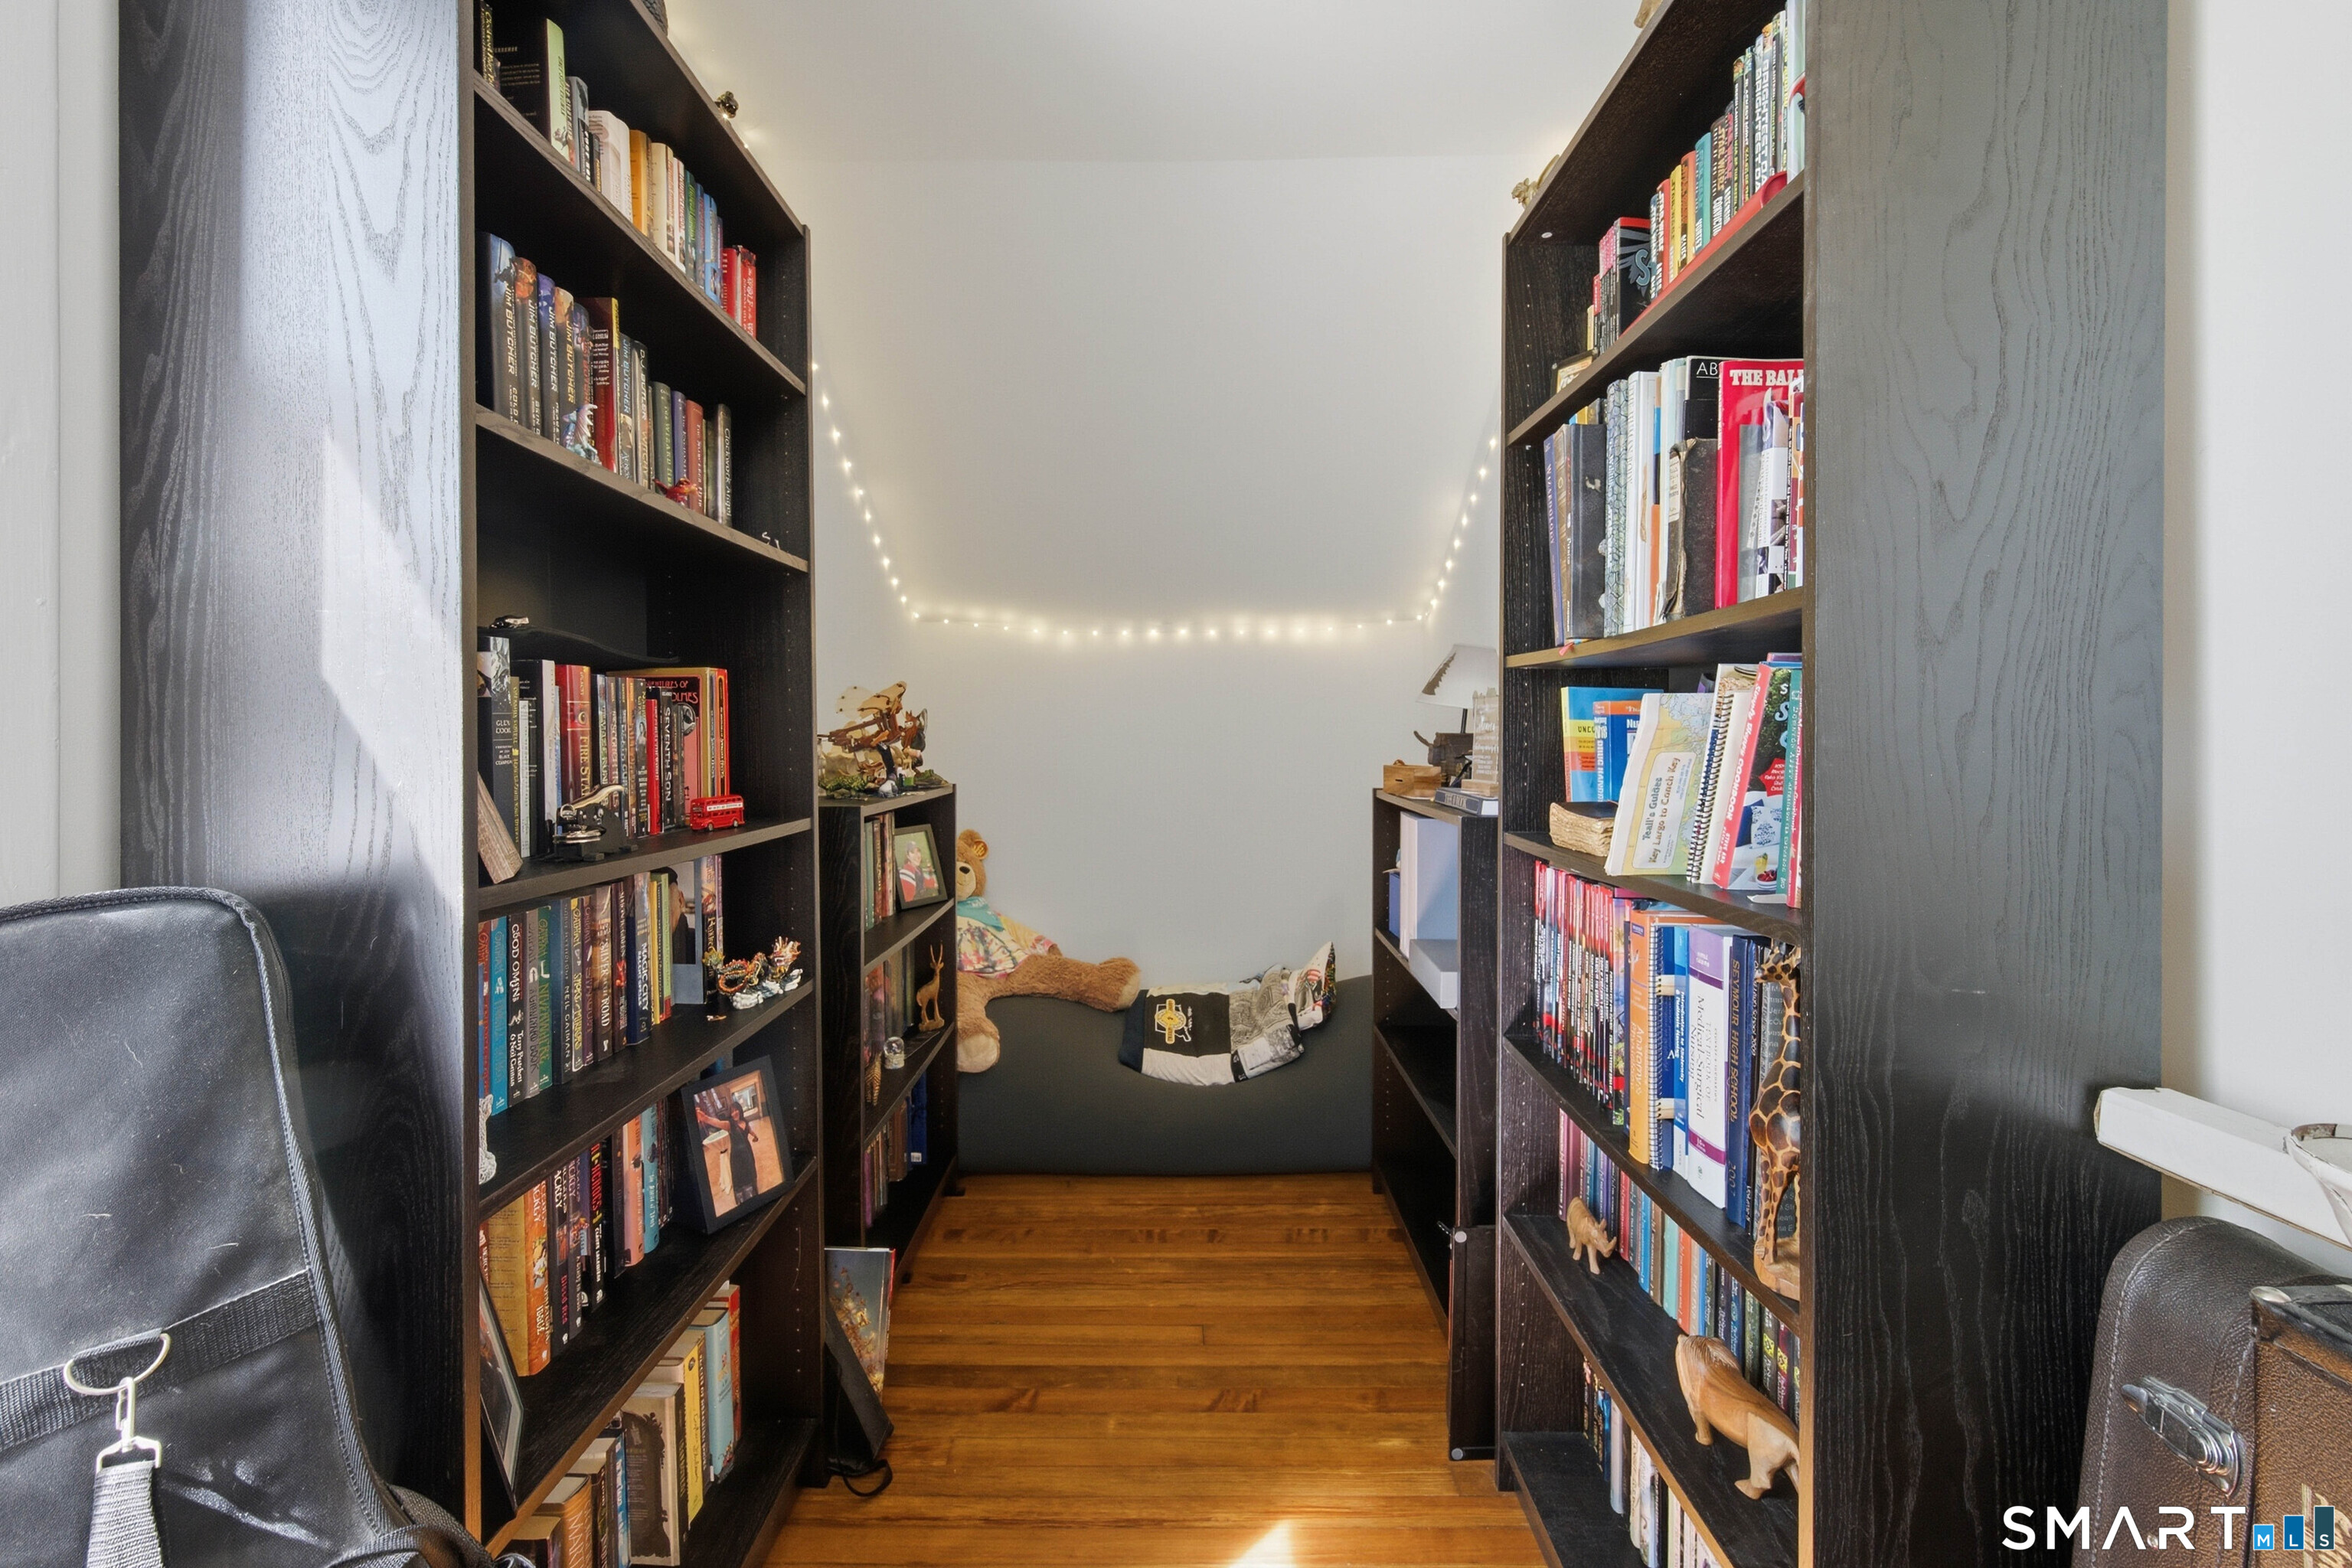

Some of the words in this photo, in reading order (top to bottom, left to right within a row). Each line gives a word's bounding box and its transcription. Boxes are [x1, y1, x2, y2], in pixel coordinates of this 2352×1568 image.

[1761, 58, 1769, 158] BRIGHTEST
[1717, 126, 1726, 158] STAR
[1717, 157, 1726, 191] WARS
[1761, 159, 1769, 186] DA
[505, 281, 513, 306] JIM
[505, 308, 515, 375] BUTCHER
[529, 325, 537, 388] BUTCHER
[549, 331, 557, 391] BUTCHER
[1697, 361, 1718, 376] AB
[1730, 369, 1762, 386] THE
[1766, 369, 1804, 386] BAL
[1546, 463, 1555, 544] WIZARDOLOGY
[1747, 684, 1761, 720] Simply
[580, 736, 590, 763] FIRE
[1668, 756, 1681, 774] Key
[580, 766, 590, 796] STA
[1648, 776, 1663, 810] Guides
[1661, 775, 1674, 804] Conch
[1726, 759, 1744, 821] COOKBOOK
[1660, 806, 1668, 817] to
[1652, 818, 1666, 846] Largo
[1648, 843, 1661, 864] Key
[511, 923, 521, 957] GOOD
[600, 941, 609, 976] SILVER
[511, 961, 521, 1002] OMENS
[1732, 959, 1740, 1025] SEYMOUR
[601, 996, 609, 1027] ROAD
[530, 1044, 538, 1073] BOOK
[1635, 1024, 1645, 1086] Anatomy
[1689, 1024, 1697, 1080] Nursing
[1694, 995, 1705, 1119] Medical-Surgical
[1731, 1030, 1740, 1063] HIGH
[1705, 1086, 1712, 1102] OF
[1730, 1066, 1740, 1123] SCHOOL
[554, 1170, 564, 1208] ACKEY
[1726, 1160, 1738, 1197] 2007
